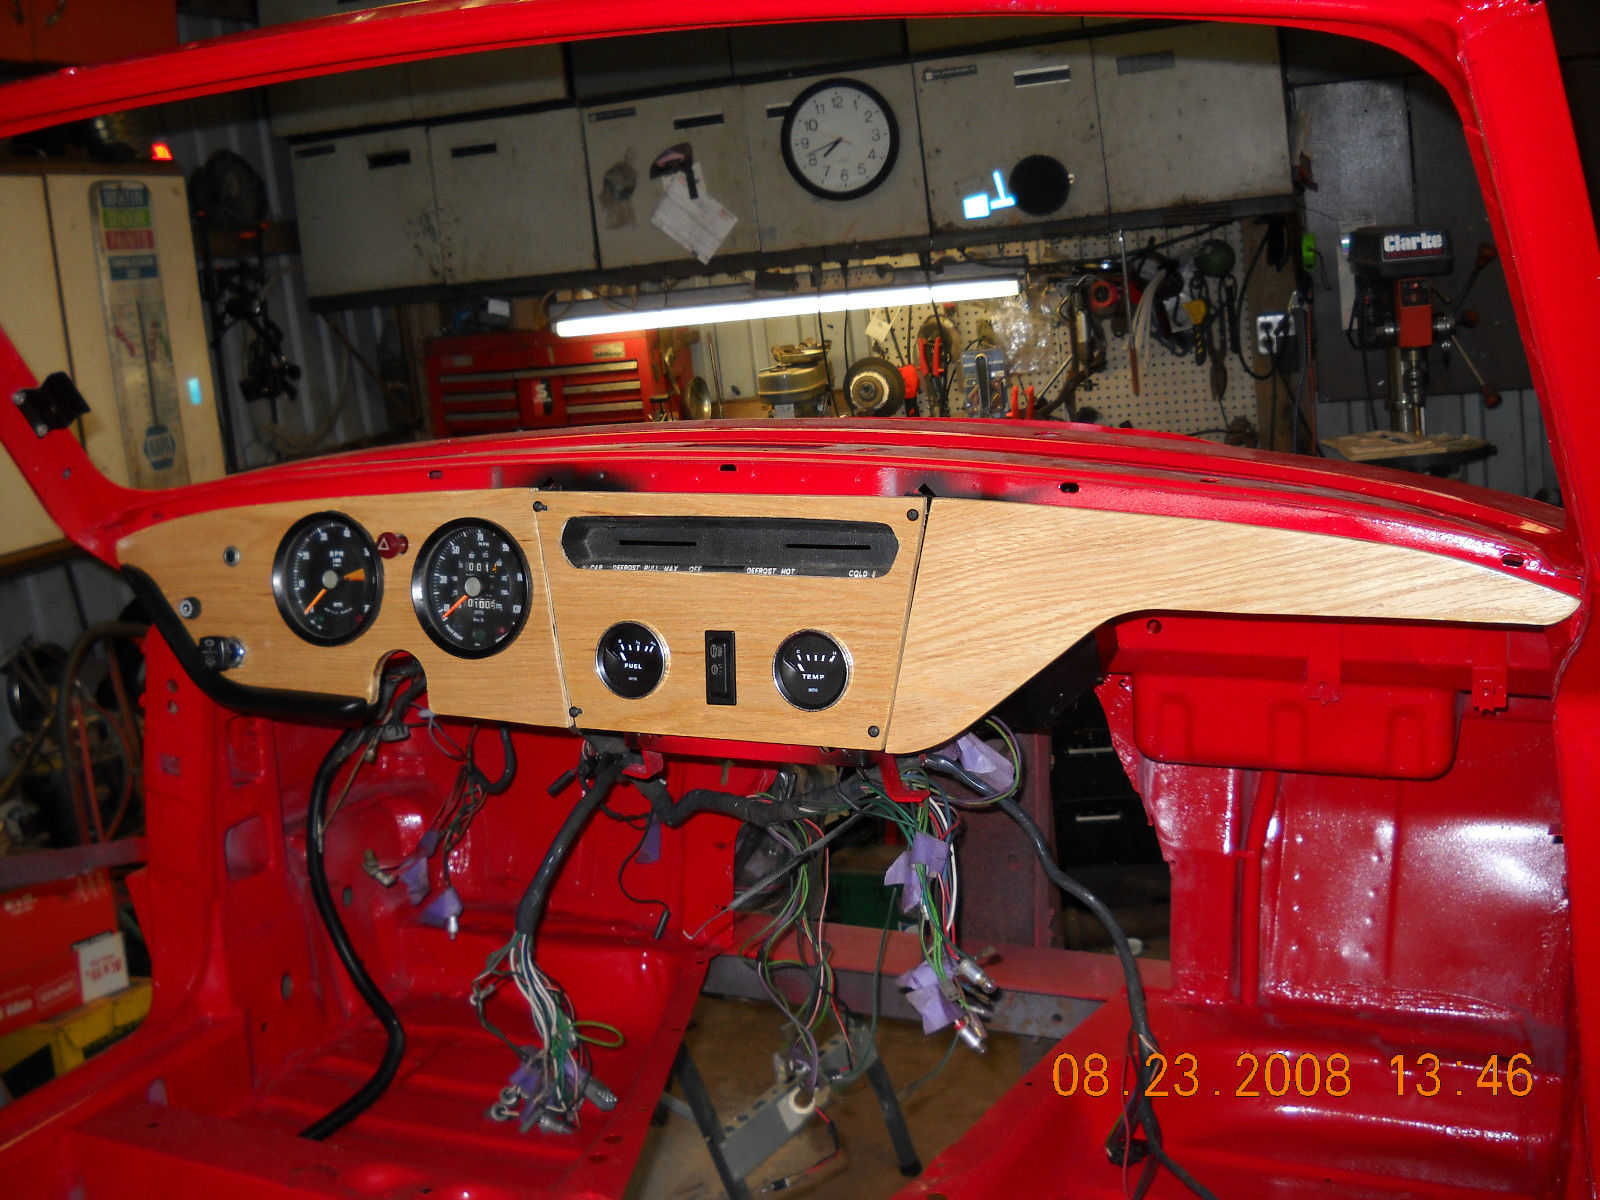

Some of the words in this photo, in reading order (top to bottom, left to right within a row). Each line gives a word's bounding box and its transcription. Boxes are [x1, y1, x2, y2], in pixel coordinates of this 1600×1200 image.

[832, 95, 843, 108] 12
[853, 99, 858, 111] 1
[816, 104, 825, 114] 11
[865, 110, 873, 122] 2
[805, 119, 818, 131] 10
[871, 128, 880, 141] 3
[800, 137, 809, 149] 9
[868, 149, 876, 159] 4
[823, 165, 830, 177] 7
[858, 162, 866, 175] 5
[841, 169, 849, 181] 6
[1383, 232, 1443, 252] Clarke
[688, 565, 703, 573] OFF
[746, 567, 777, 575] DEFROST
[780, 568, 796, 576] HOT
[848, 569, 869, 578] COLD
[624, 662, 642, 670] FUEL
